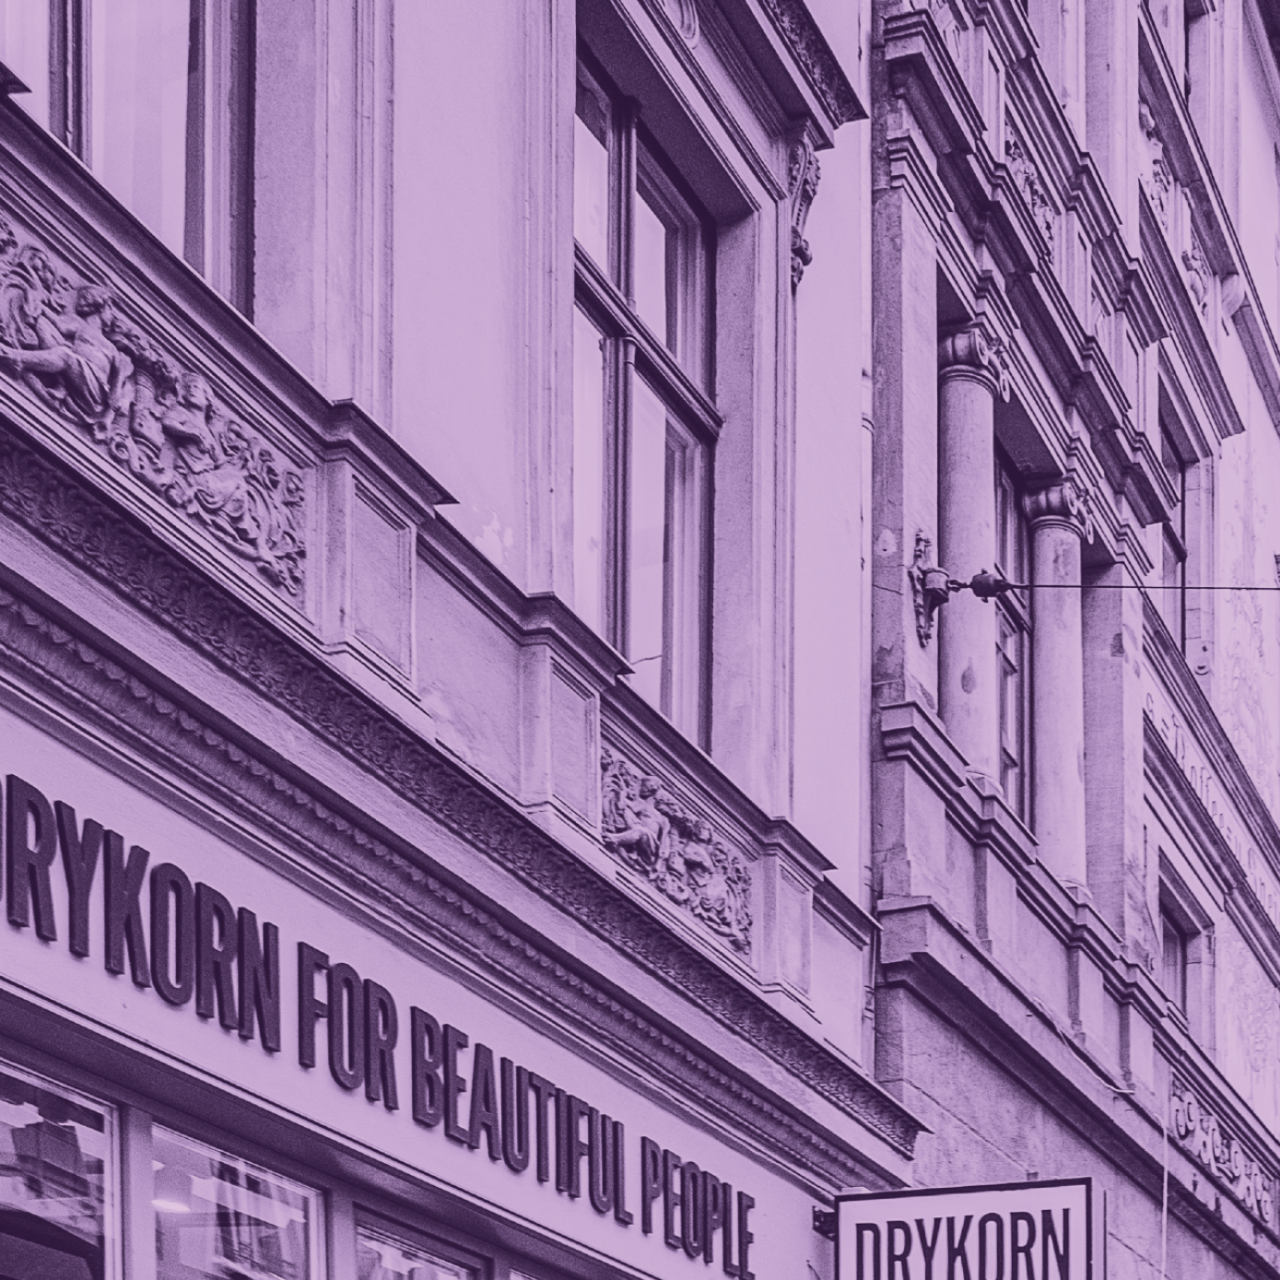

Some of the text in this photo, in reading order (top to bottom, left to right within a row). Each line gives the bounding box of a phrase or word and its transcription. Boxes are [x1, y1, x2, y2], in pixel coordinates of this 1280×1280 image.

[0, 773, 281, 1052] RYKORN
[297, 941, 399, 1111] FOR
[411, 1005, 633, 1226] BEAUTIFUL
